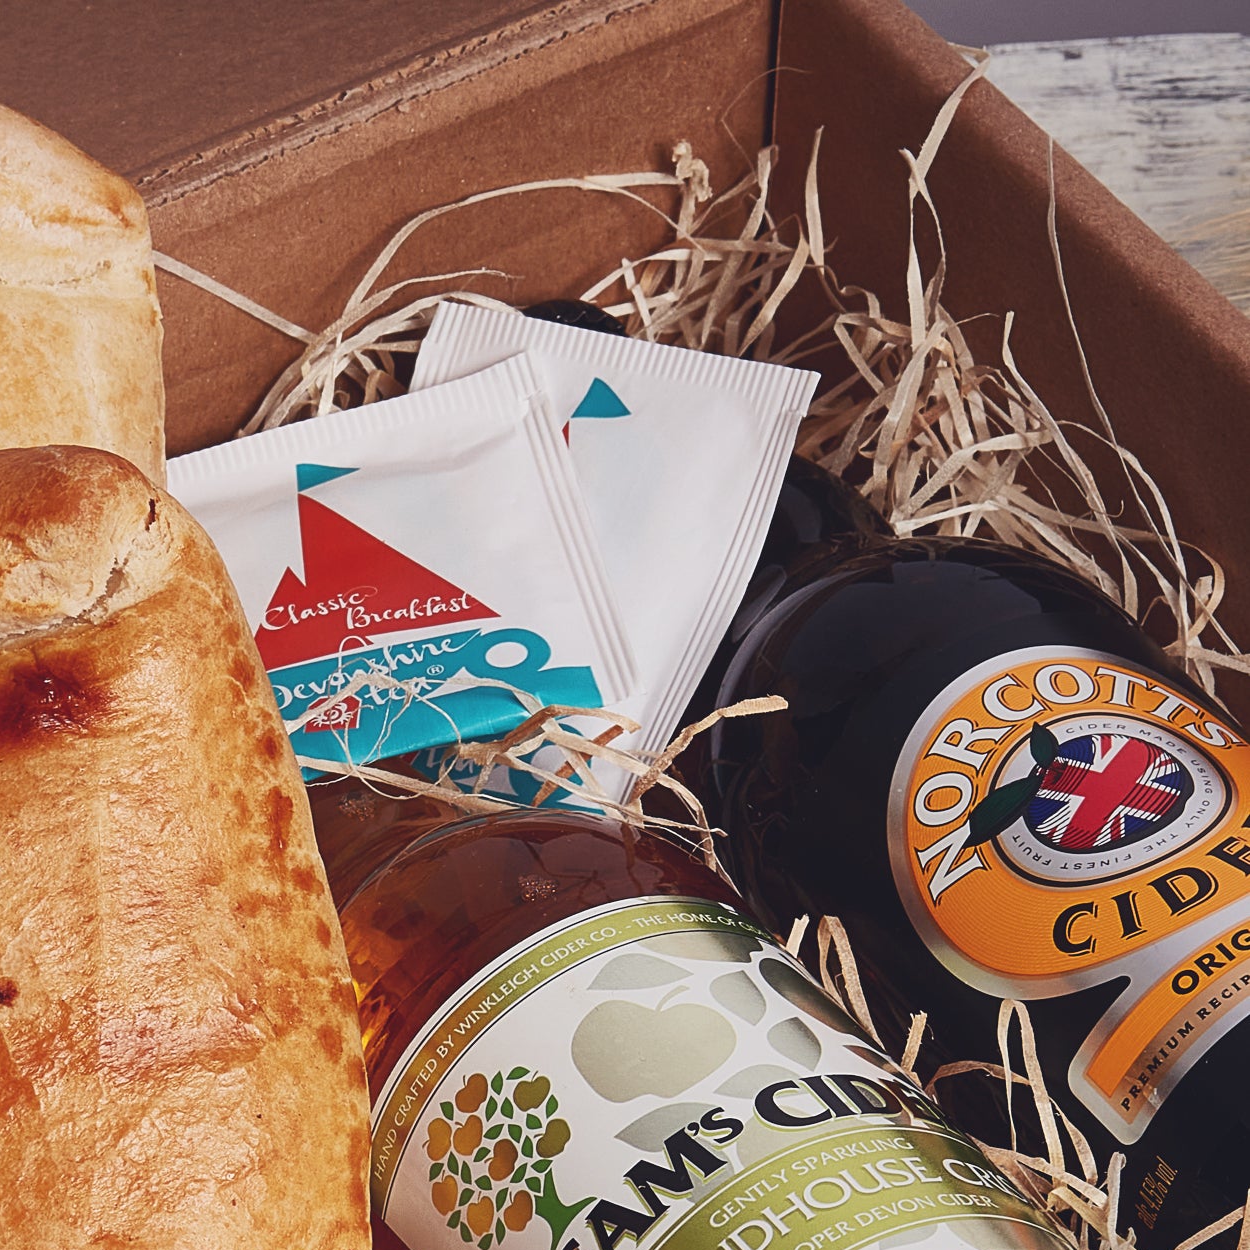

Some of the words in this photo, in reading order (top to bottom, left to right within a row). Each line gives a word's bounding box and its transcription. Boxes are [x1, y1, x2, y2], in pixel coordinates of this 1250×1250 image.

[261, 586, 376, 631] Classic
[345, 591, 475, 630] Breakfast
[1065, 722, 1127, 734] CIDER
[1139, 728, 1188, 757] MADE
[913, 663, 1249, 907] NORCOTTS
[1190, 759, 1214, 795] USING
[1185, 800, 1210, 829] ONLY
[1011, 833, 1052, 867] FRUIT
[1060, 853, 1133, 870] FINEST
[1143, 832, 1180, 853] THE
[1052, 828, 1250, 956] CIDE
[374, 1130, 398, 1181] HAND
[393, 1058, 438, 1126] CRAFTED
[436, 1034, 455, 1058] BY
[453, 963, 540, 1037] WINKLEIGH
[540, 937, 591, 967] CIDER
[589, 926, 623, 943] CO.
[632, 914, 667, 928] THE
[667, 912, 717, 924] HOME
[717, 916, 737, 927] OF
[1120, 1020, 1195, 1112] PREMIUM
[753, 1073, 958, 1135] CIDE
[708, 1169, 788, 1228] GENTLY
[792, 1136, 914, 1176] SPARKLING
[1139, 1172, 1169, 1212] 4.5%
[1155, 1154, 1179, 1186] vol.
[855, 1194, 936, 1228] DEVON
[937, 1193, 1000, 1209] CIDER
